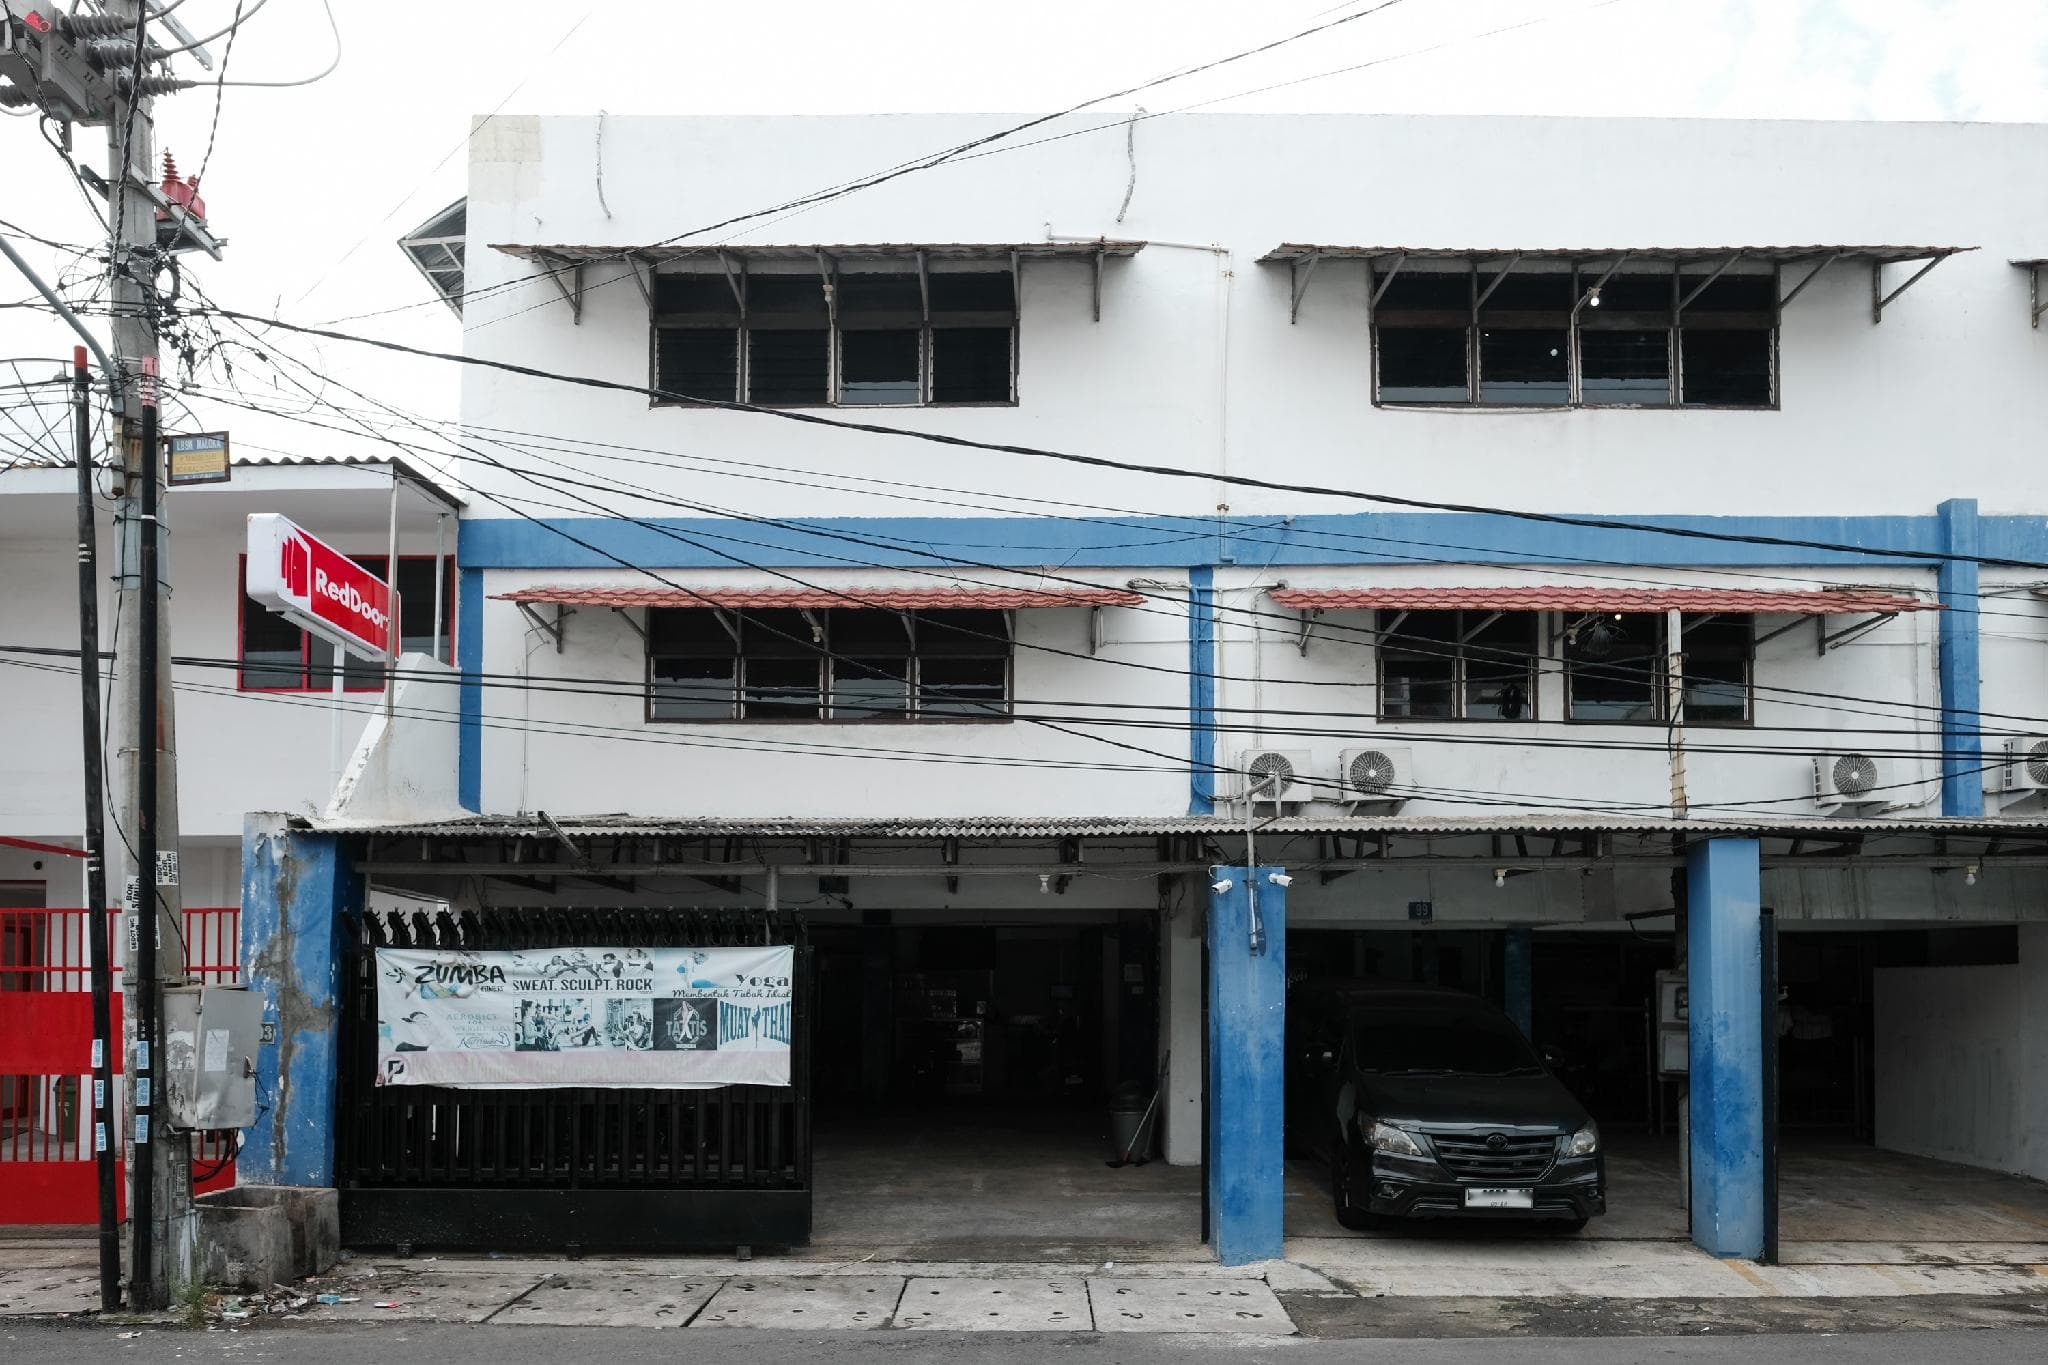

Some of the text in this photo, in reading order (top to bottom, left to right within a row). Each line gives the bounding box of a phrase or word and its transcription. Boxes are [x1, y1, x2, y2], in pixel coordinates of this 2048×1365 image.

[126, 883, 134, 901] BOR
[413, 963, 507, 985] ZUMBA
[736, 974, 789, 988] Yoga
[512, 978, 652, 991] SWEAT. SCULPT. ROCK
[719, 1001, 791, 1045] MUAY THAI
